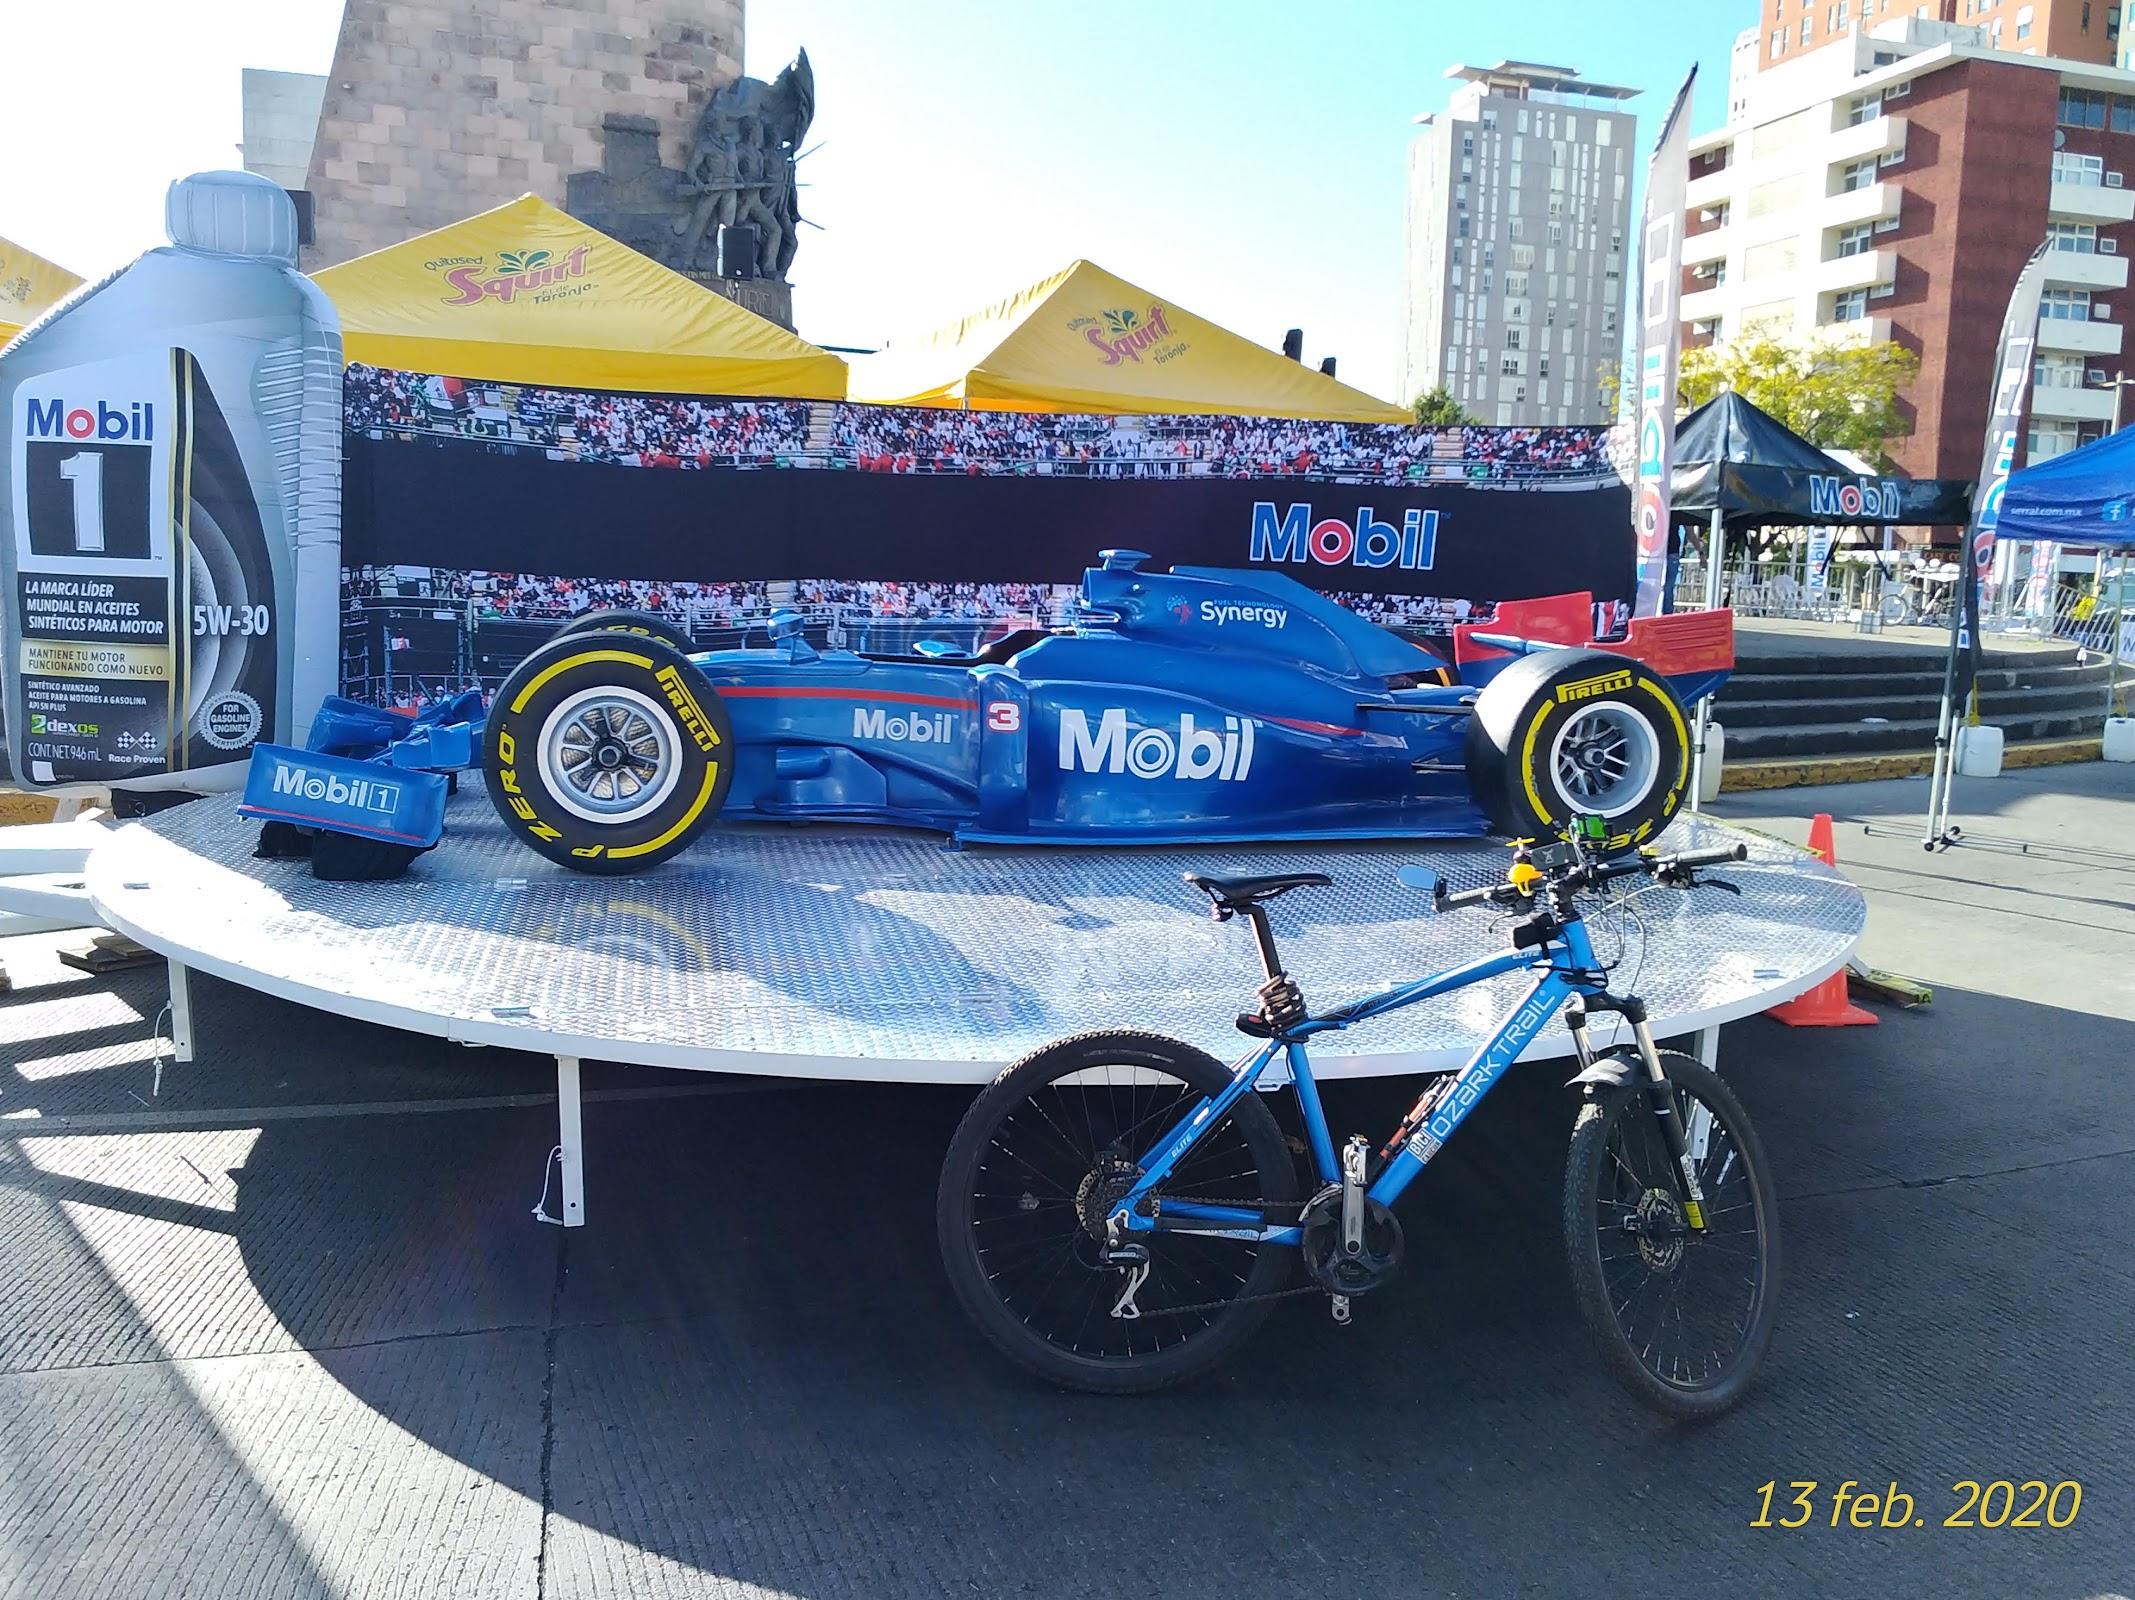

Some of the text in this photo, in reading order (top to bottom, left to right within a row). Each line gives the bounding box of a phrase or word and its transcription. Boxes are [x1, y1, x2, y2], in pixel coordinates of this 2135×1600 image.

[424, 256, 483, 272] Quitased
[441, 242, 593, 306] Squirt
[1083, 302, 1172, 367] Squirt
[27, 398, 153, 441] Mobil
[60, 452, 105, 551] 1
[1809, 474, 1900, 518] Mobil
[2010, 507, 2083, 516] serral.com.mx
[1250, 502, 1439, 570] Mobil
[1811, 542, 1826, 588] Mobil
[25, 580, 114, 597] LA MARCA LÍDER
[26, 599, 140, 616] MUNDIAL EN ACEITES
[1200, 600, 1287, 628] Synergy
[28, 614, 164, 634] SINTÉTICOS PARA MOTOR
[193, 605, 269, 636] 5W-30
[28, 659, 164, 675] FUNCIONANDO COMO NUEVO
[29, 648, 125, 662] MANTIENE TU MOTOR
[28, 680, 99, 693] SINTÉTICO AVANZADO
[28, 691, 147, 706] ACEITE PARA MOTORES A GASOLINA
[1556, 669, 1633, 704] PIRELLI
[50, 703, 66, 712] PLUS
[211, 714, 250, 723] GASOLINE
[222, 704, 239, 713] FOR
[655, 665, 721, 752] PIRELLI
[988, 702, 1021, 733] 3
[47, 719, 99, 735] dexos
[213, 724, 248, 733] ENGINES
[853, 708, 951, 743] Mobil
[87, 748, 102, 761] mL
[1059, 708, 1255, 781] Mobil
[108, 754, 166, 764] Race Proven
[273, 765, 368, 808] Mobil
[499, 731, 563, 842] ZERO
[1409, 1131, 1432, 1155] BICI
